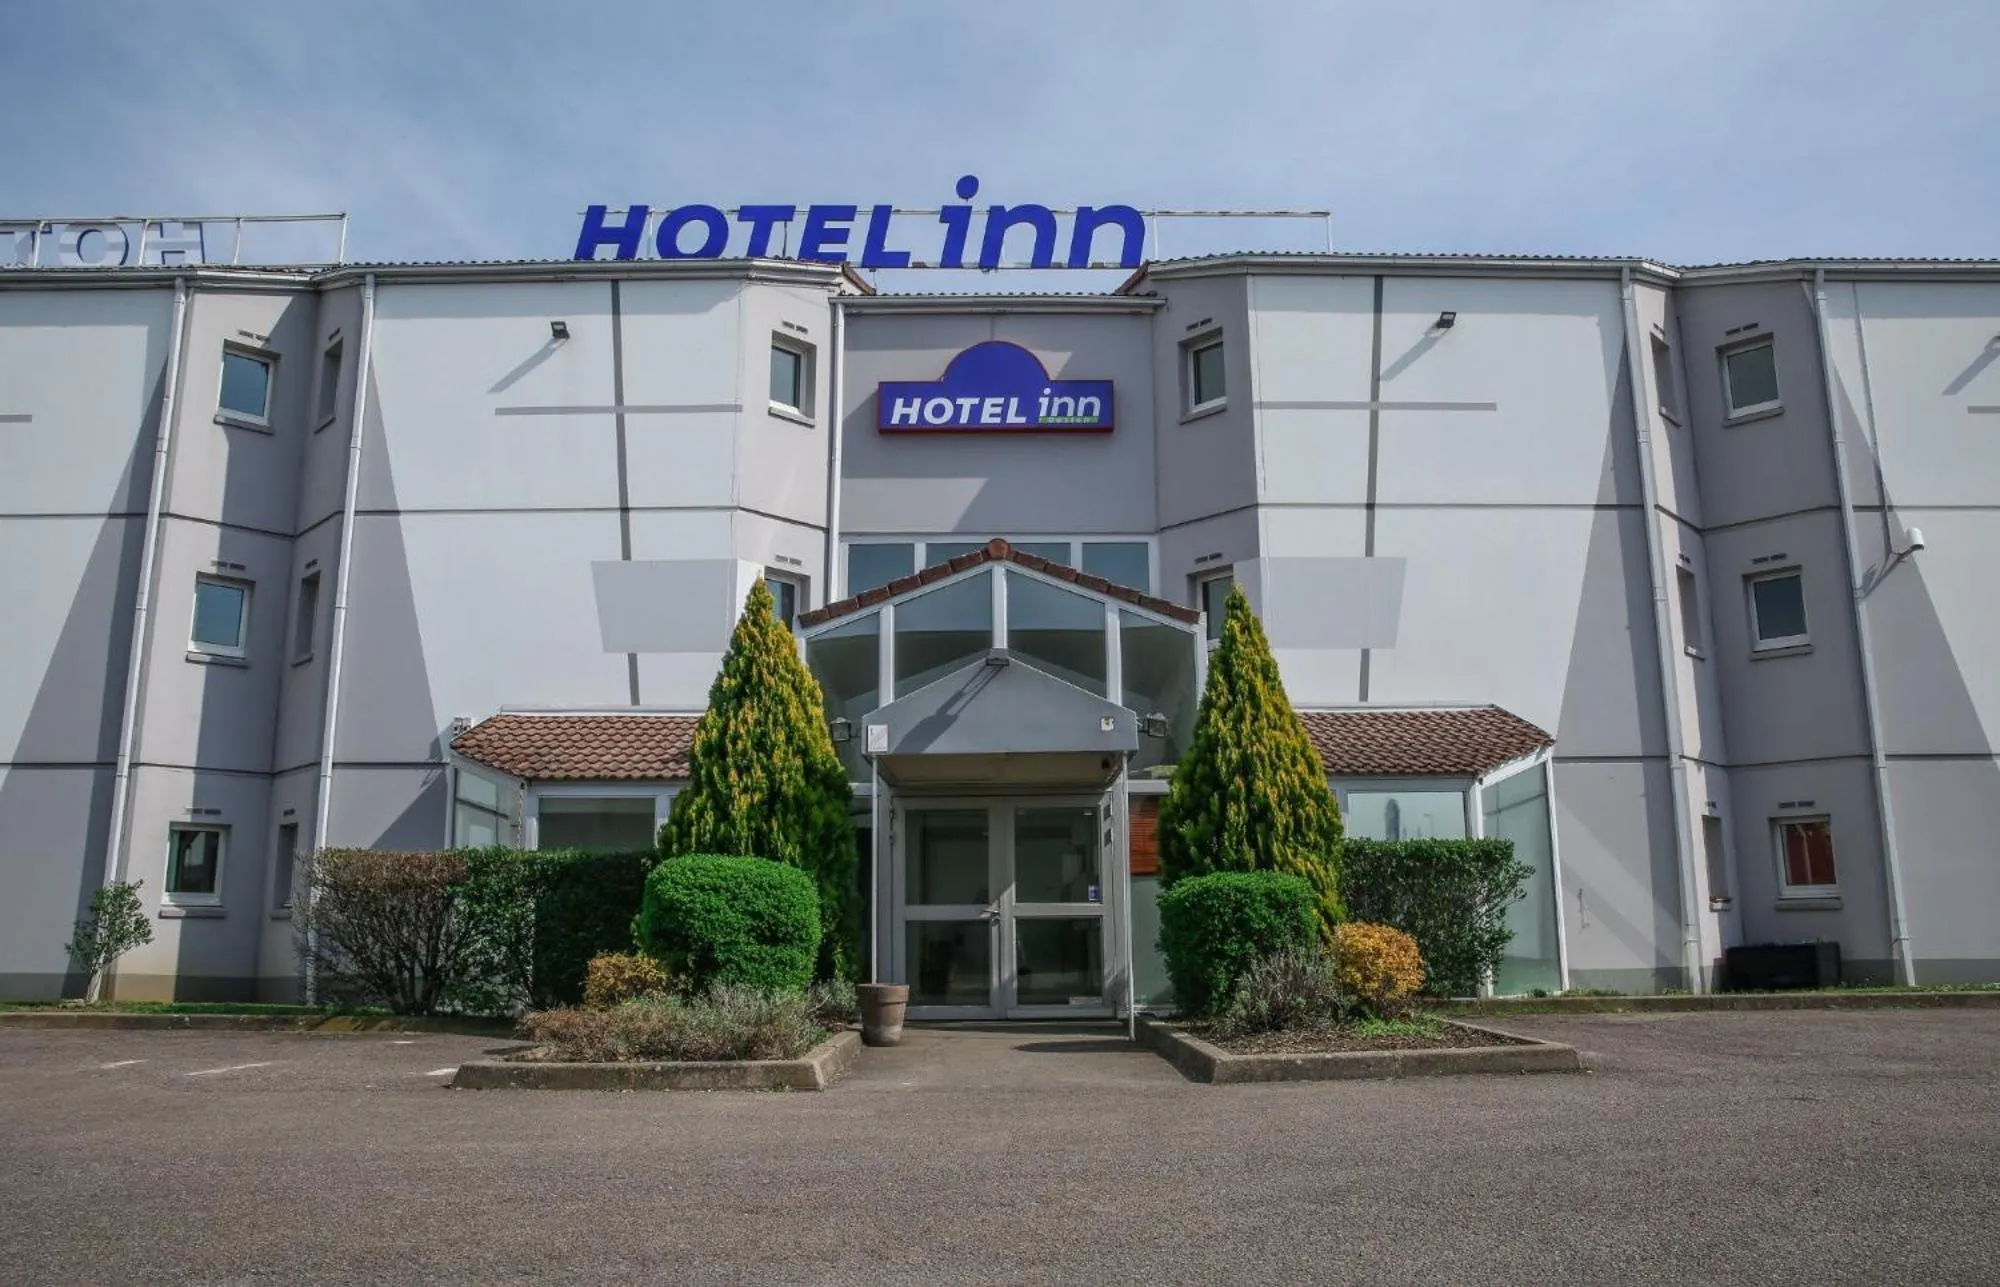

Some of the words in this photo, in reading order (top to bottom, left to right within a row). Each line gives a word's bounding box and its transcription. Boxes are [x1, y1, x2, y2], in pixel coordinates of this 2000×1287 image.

[573, 204, 911, 268] HOTEL
[939, 174, 1146, 269] inn
[890, 397, 1027, 425] HOTEL
[1039, 387, 1101, 417] inn
